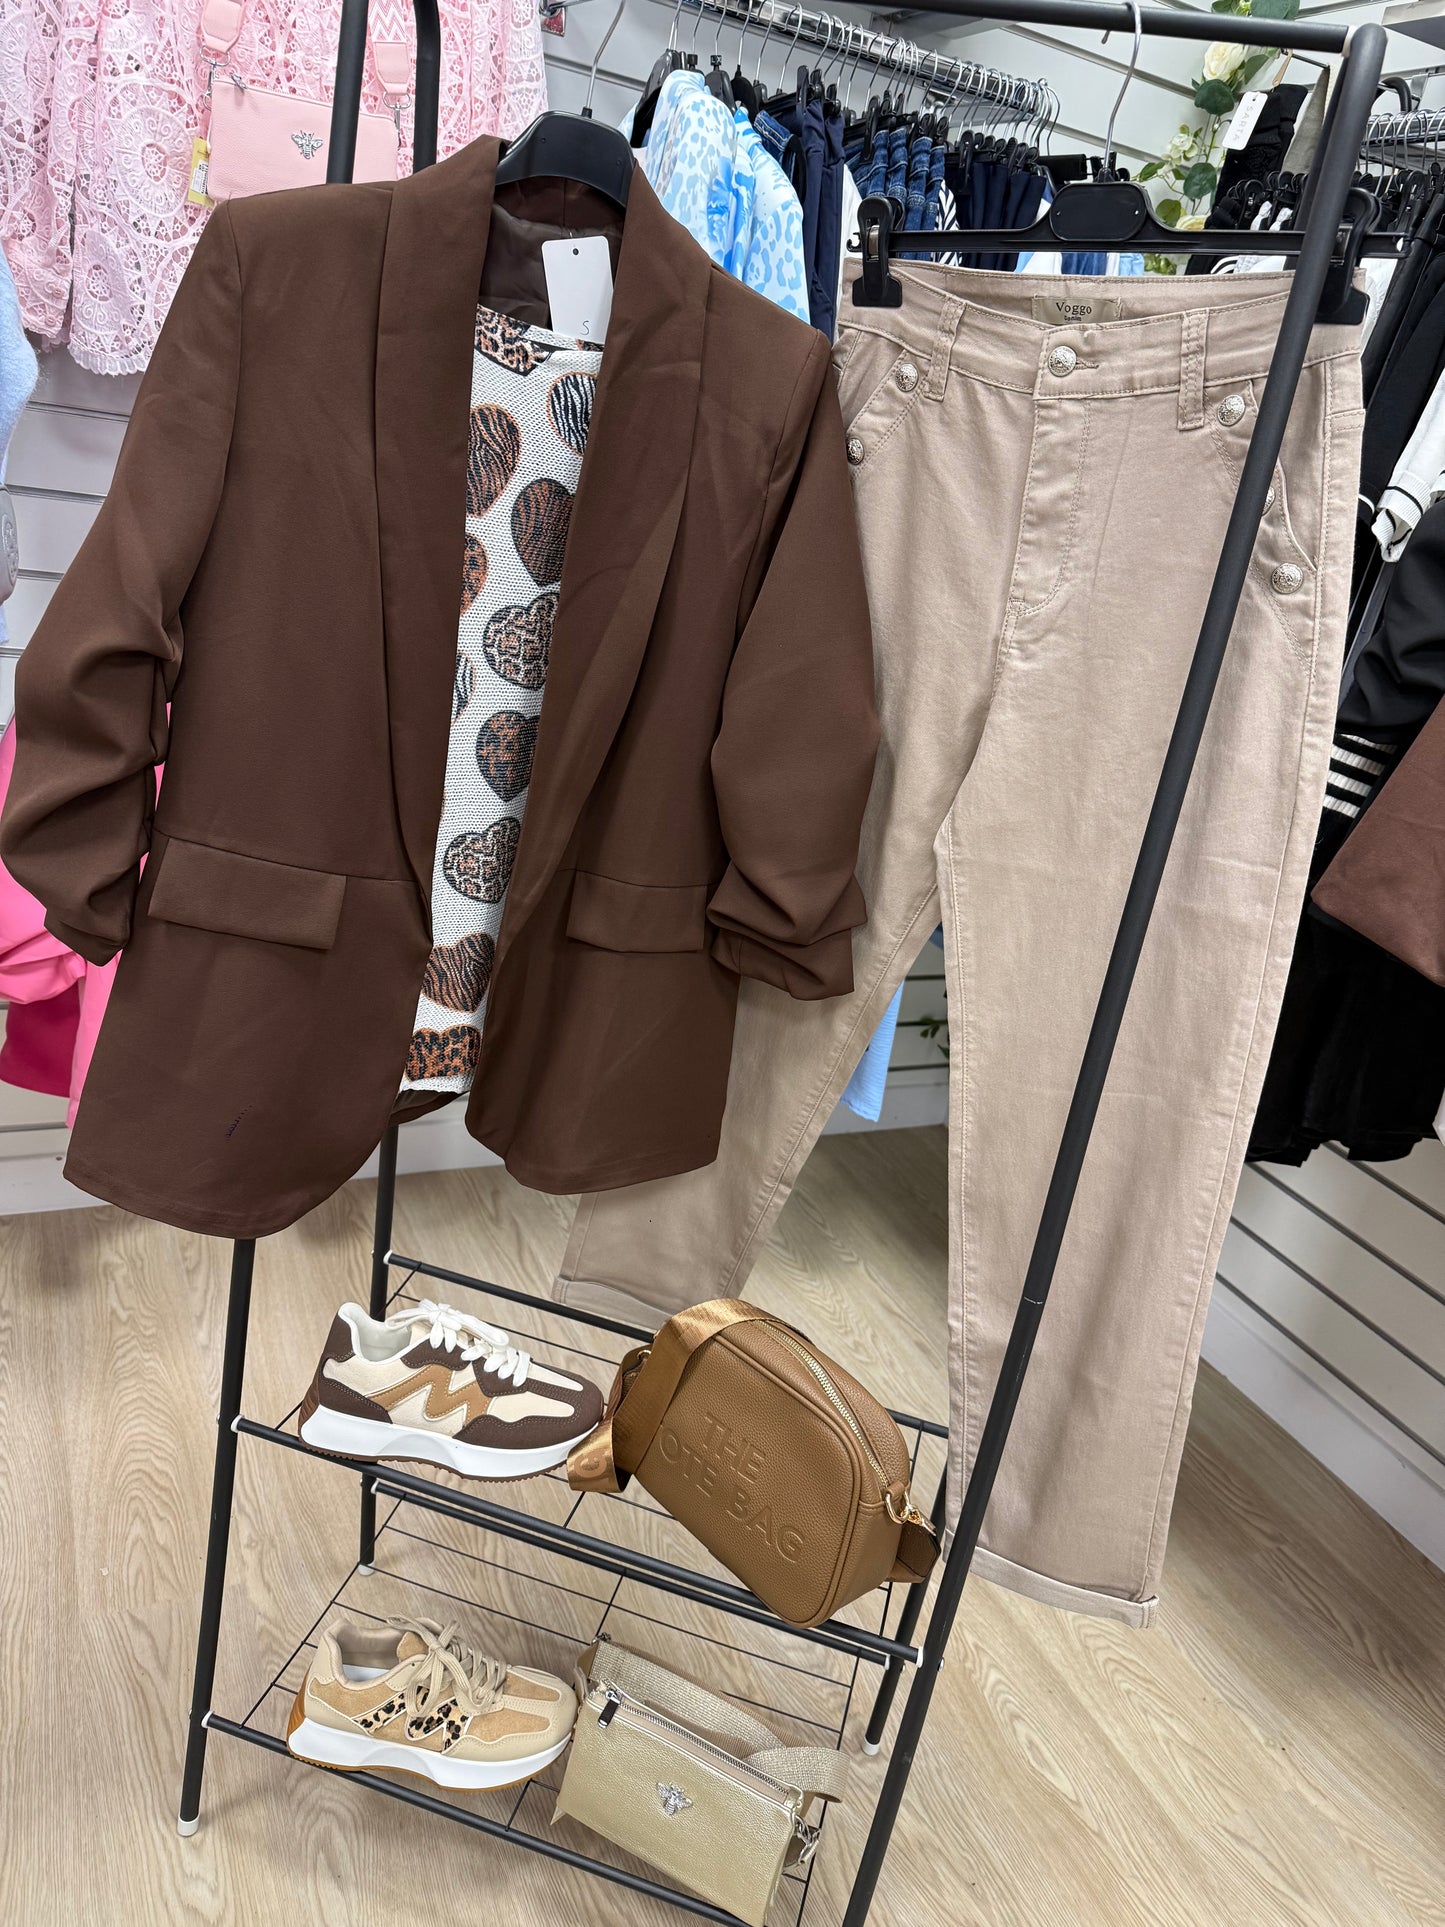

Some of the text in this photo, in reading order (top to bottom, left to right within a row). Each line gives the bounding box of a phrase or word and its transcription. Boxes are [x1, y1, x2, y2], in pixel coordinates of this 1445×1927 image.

[1233, 105, 1253, 141] SARTA
[1055, 301, 1092, 316] Voggo
[580, 320, 590, 336] S
[702, 1412, 768, 1485] THE
[660, 1425, 804, 1564] OTE BAG
